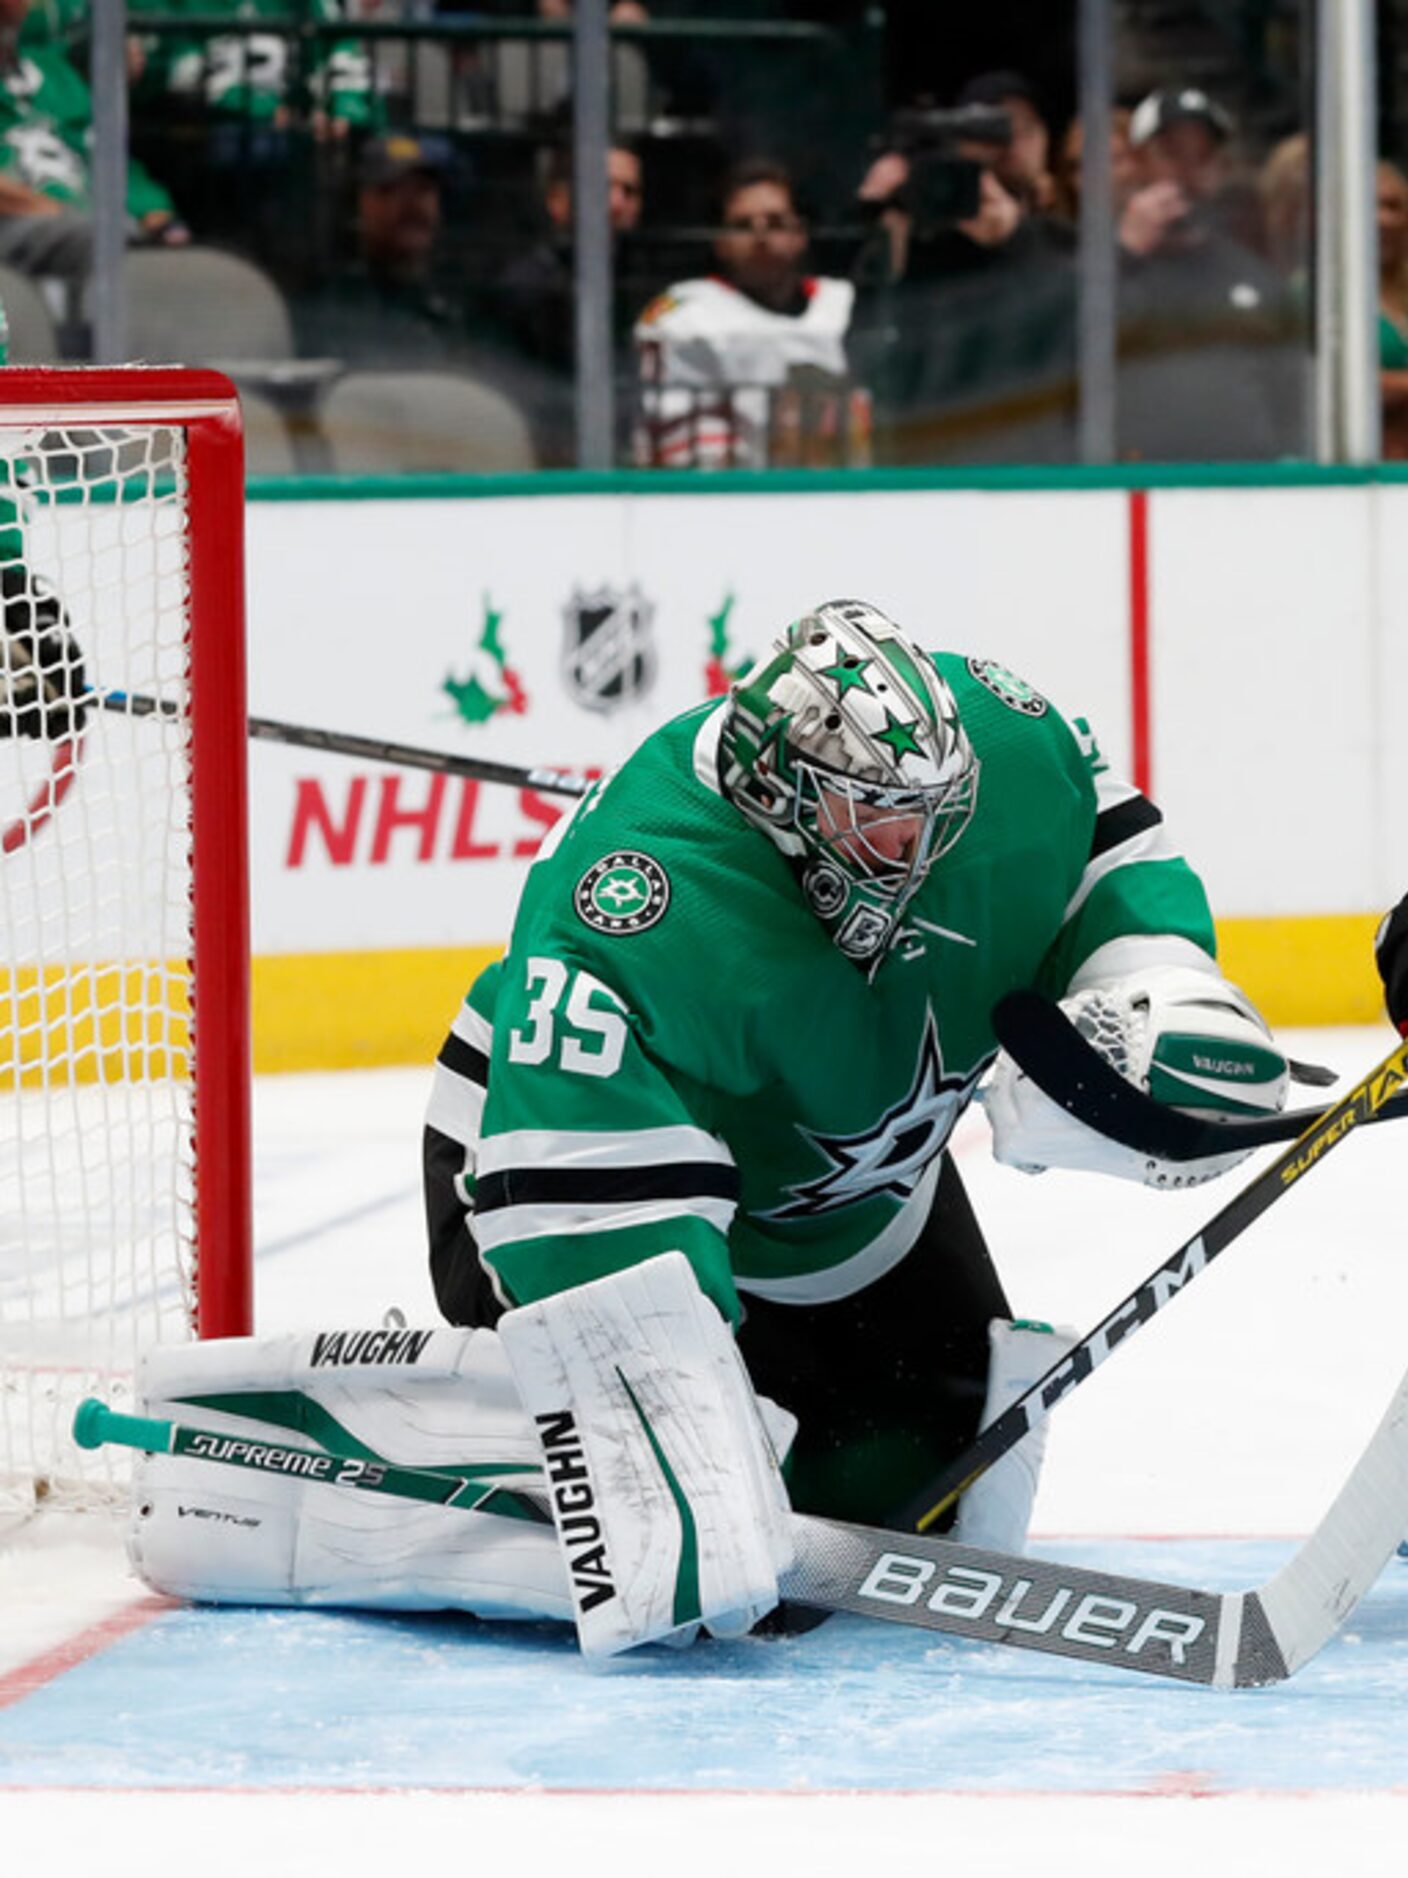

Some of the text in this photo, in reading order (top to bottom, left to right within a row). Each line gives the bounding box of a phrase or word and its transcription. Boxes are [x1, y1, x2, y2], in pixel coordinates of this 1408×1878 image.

[285, 765, 602, 869] NHLS
[508, 956, 630, 1078] 35
[1191, 1054, 1256, 1076] VAUGHN
[1280, 1107, 1357, 1184] SUPER
[309, 1330, 436, 1368] VAUGHN
[1017, 1233, 1208, 1438] CCM
[185, 1433, 332, 1478] SUPREME
[534, 1409, 617, 1613] VAUGHN
